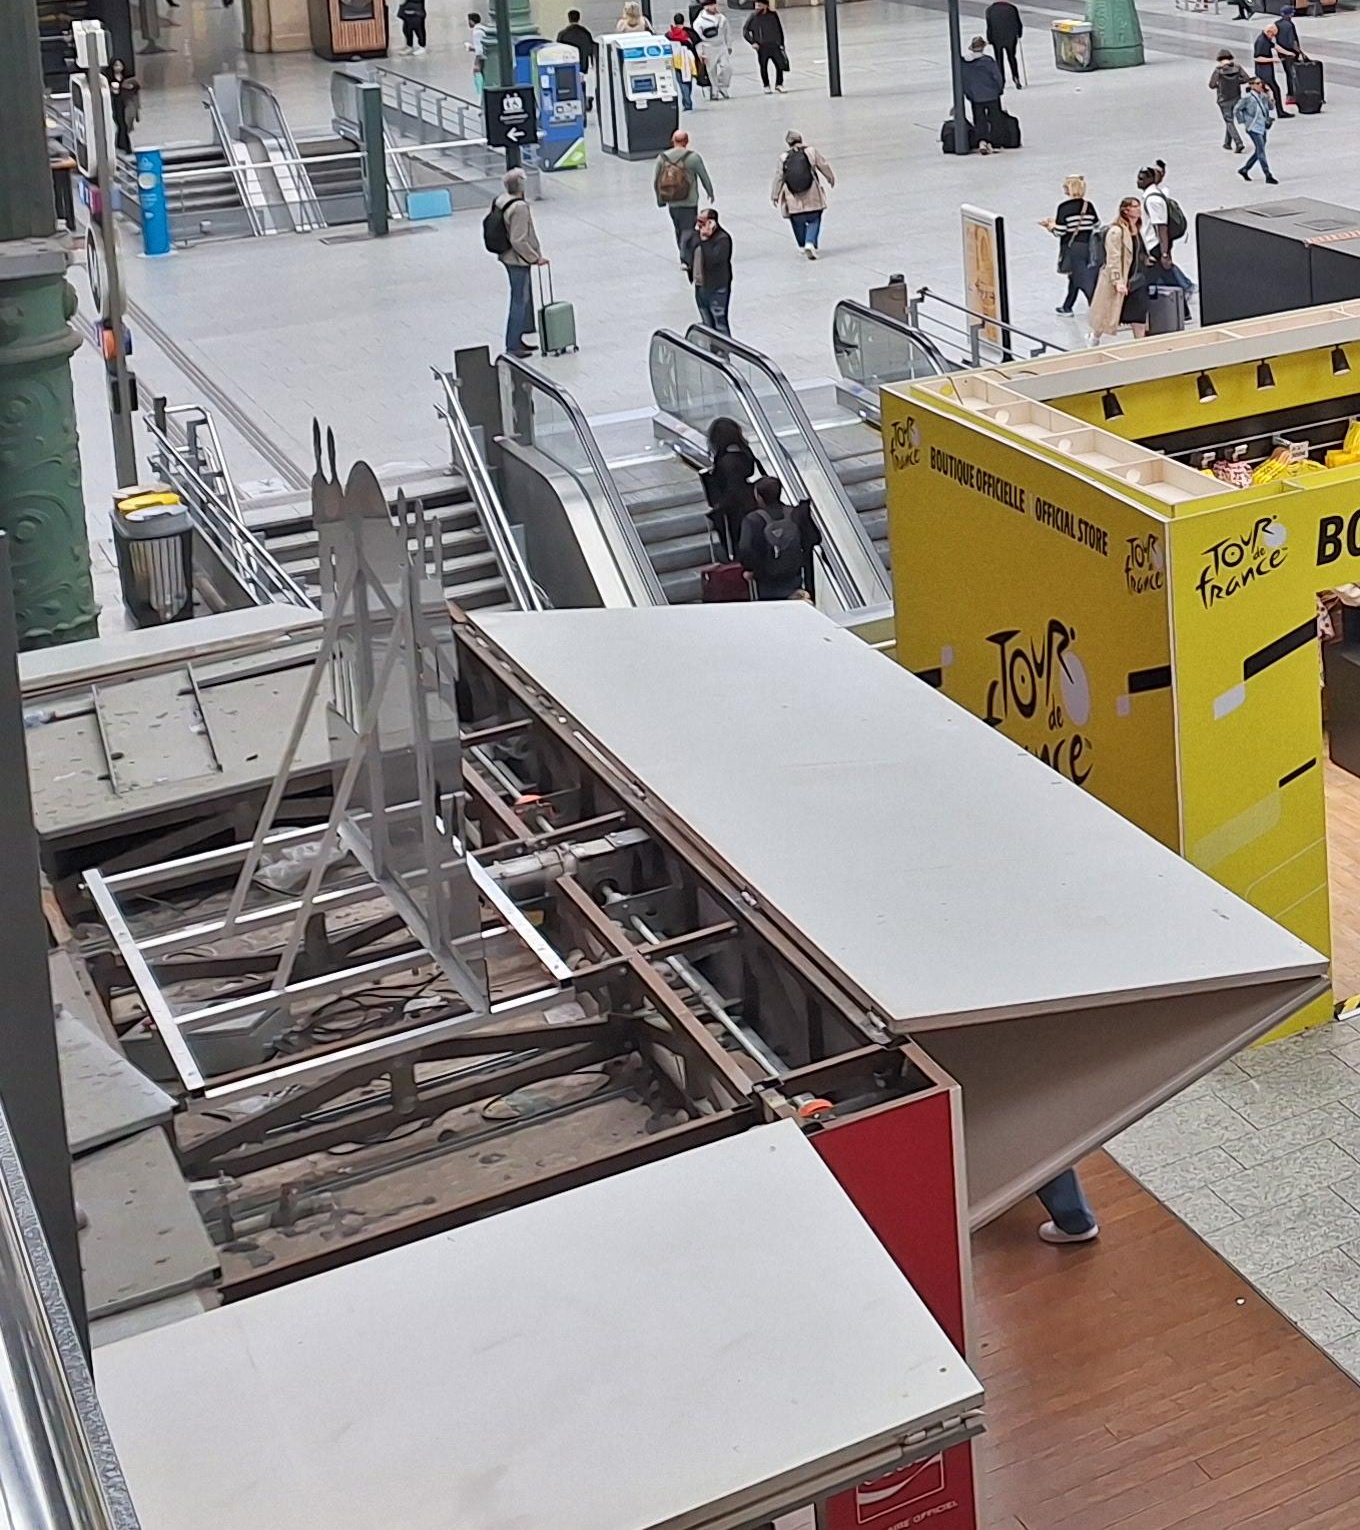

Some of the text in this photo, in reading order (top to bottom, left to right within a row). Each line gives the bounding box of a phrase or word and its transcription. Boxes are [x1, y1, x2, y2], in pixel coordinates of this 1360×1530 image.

[930, 446, 1025, 514] BOUTIQUE OFFICIELLE
[1035, 496, 1108, 557] OFFICIAL STORE
[1201, 514, 1279, 571] TOUR
[1252, 546, 1267, 561] de
[1195, 548, 1288, 610] france
[984, 618, 1076, 719] TOUR
[1048, 693, 1064, 731] de
